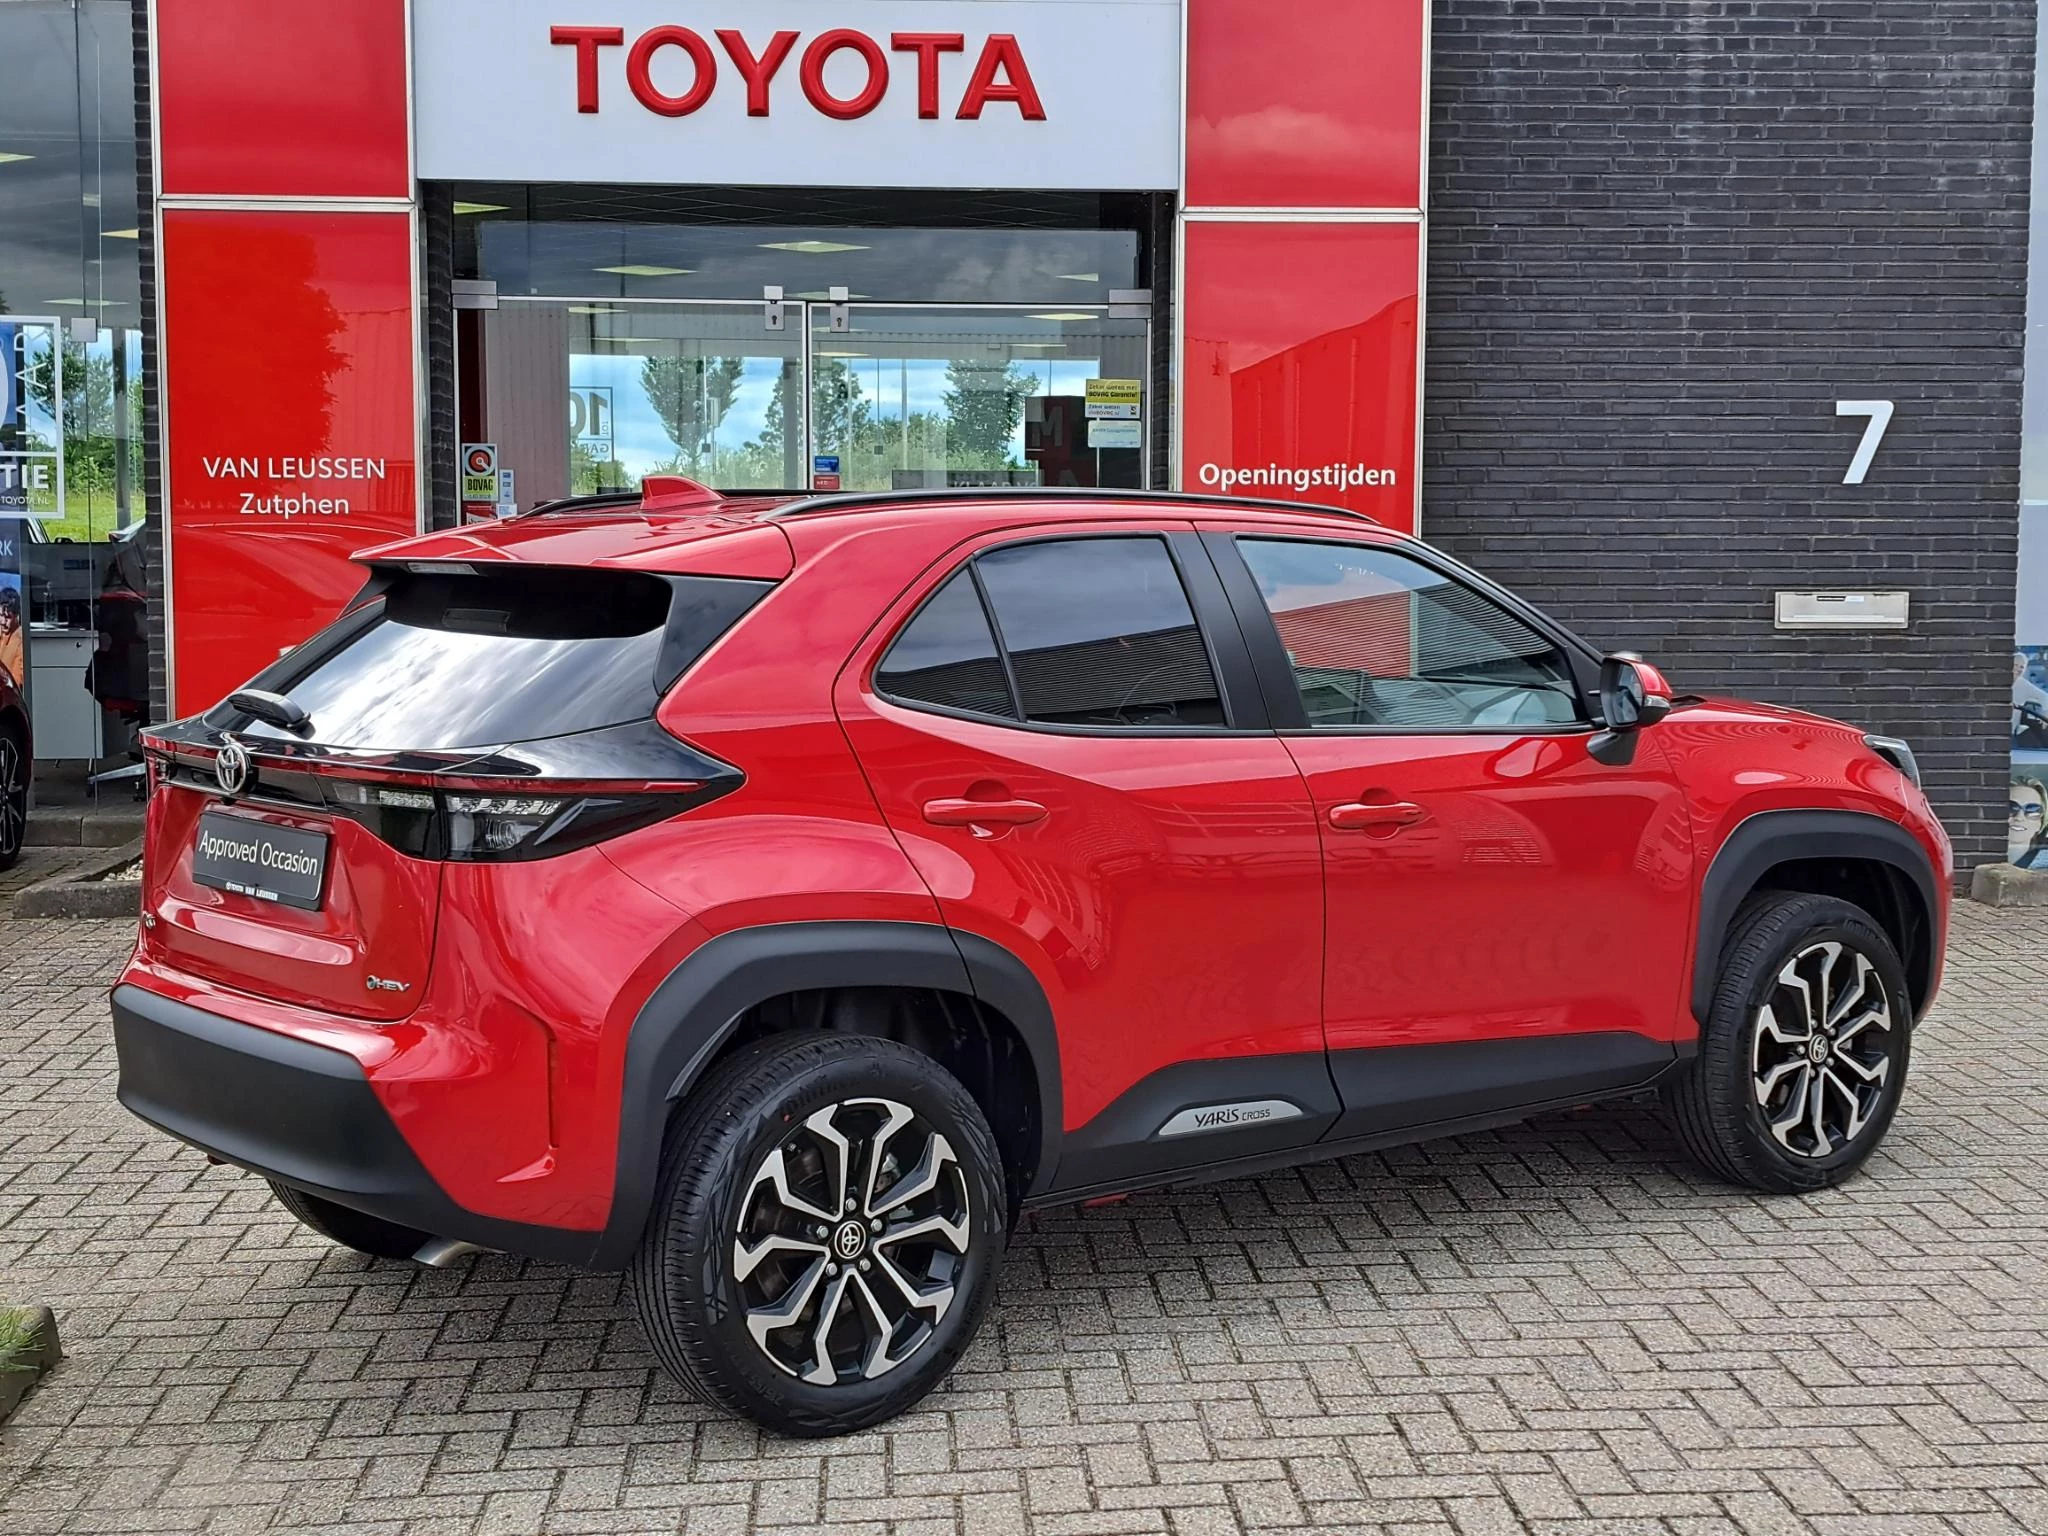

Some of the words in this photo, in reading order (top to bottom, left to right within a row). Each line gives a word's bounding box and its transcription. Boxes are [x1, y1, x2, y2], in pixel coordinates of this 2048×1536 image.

[550, 25, 1047, 121] TOYOTA
[1836, 400, 1894, 484] 7
[203, 457, 258, 478] VAN
[268, 457, 385, 479] LEUSSEN
[1199, 463, 1396, 492] Openingstijden
[467, 479, 493, 491] BOVAG
[240, 493, 349, 520] Zutphen
[199, 830, 259, 864] Approved
[260, 842, 318, 876] Occasion
[1242, 1109, 1271, 1121] CROSS
